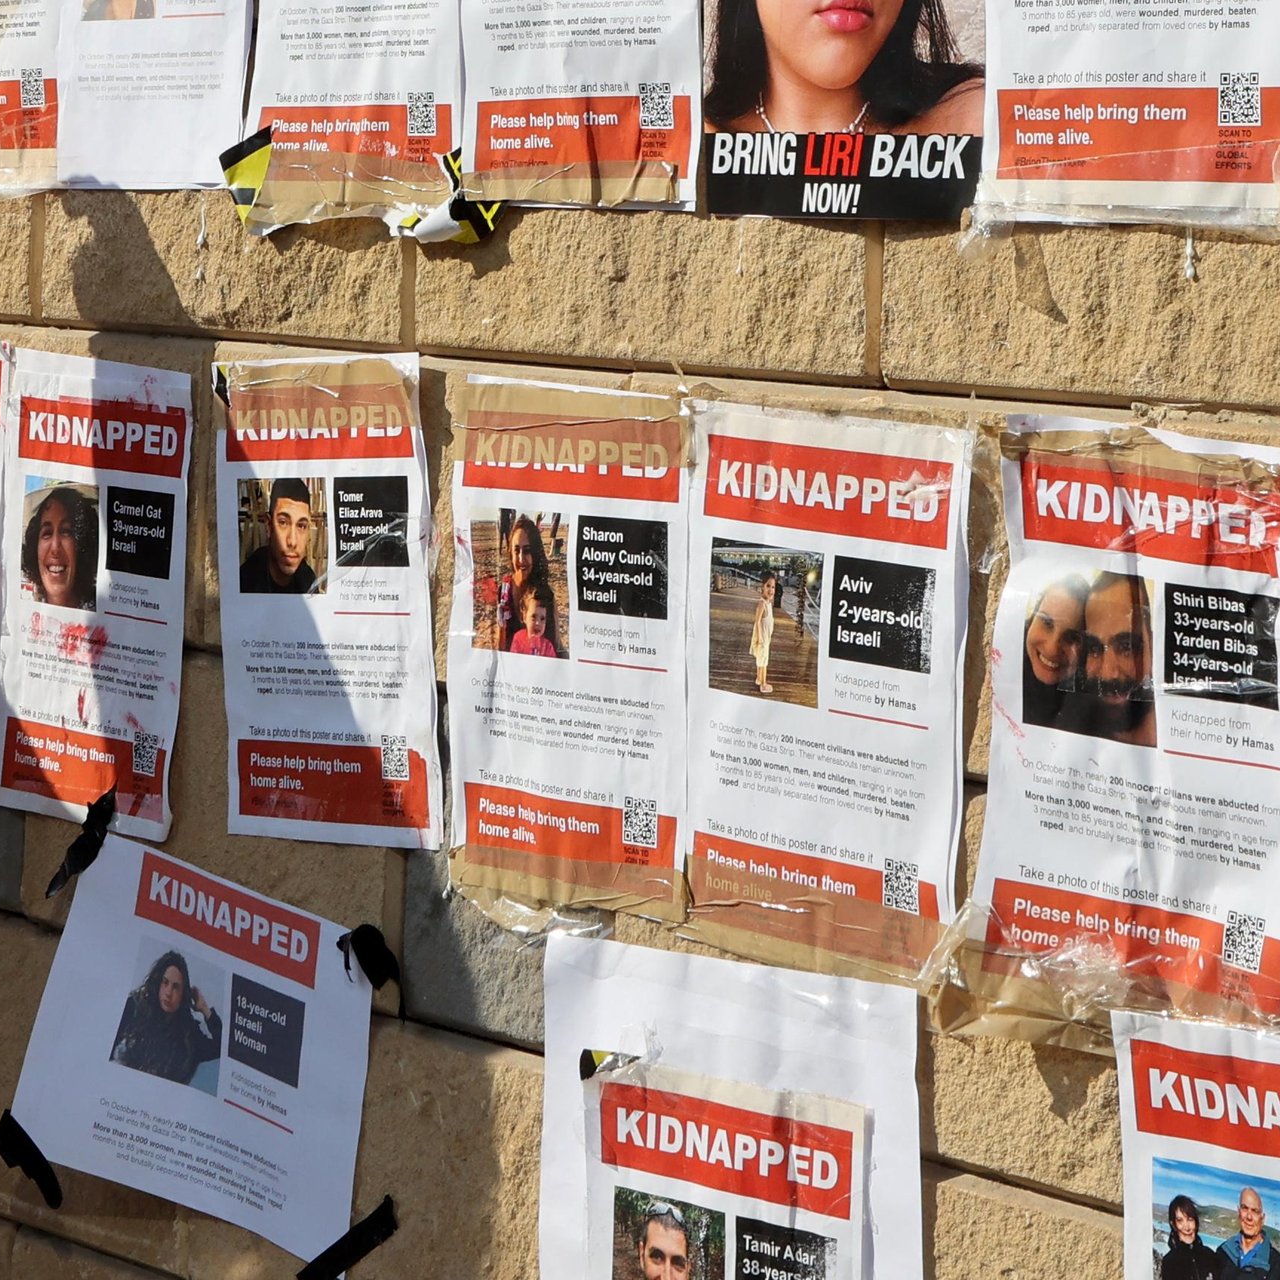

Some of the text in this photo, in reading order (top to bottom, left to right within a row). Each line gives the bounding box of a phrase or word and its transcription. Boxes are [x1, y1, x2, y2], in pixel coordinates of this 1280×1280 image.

[712, 132, 965, 179] BRING LIRI BACK
[802, 183, 861, 214] NOW!
[29, 411, 177, 456] KIDNAPPED
[236, 411, 402, 441] KIDNAPPED
[475, 436, 668, 478] KIDNAPPED
[338, 491, 363, 502] Tomer
[718, 459, 942, 522] KIDNAPPED
[113, 501, 161, 519] Carmel Gat
[339, 507, 383, 518] Eliaz Arava
[113, 520, 165, 539] 39-years-old
[583, 526, 623, 543] Sharon
[582, 547, 656, 568] Alony Cunio,
[839, 575, 873, 594] Aviv
[1173, 592, 1245, 613] Shiri Bibas
[1174, 631, 1258, 656] Yarden Bibas
[149, 871, 308, 962] KIDNAPPED
[237, 995, 286, 1026] 18-year-old
[234, 1029, 267, 1054] Woman
[617, 1107, 838, 1189] KIDNAPPED
[743, 1235, 781, 1257] Tamir
